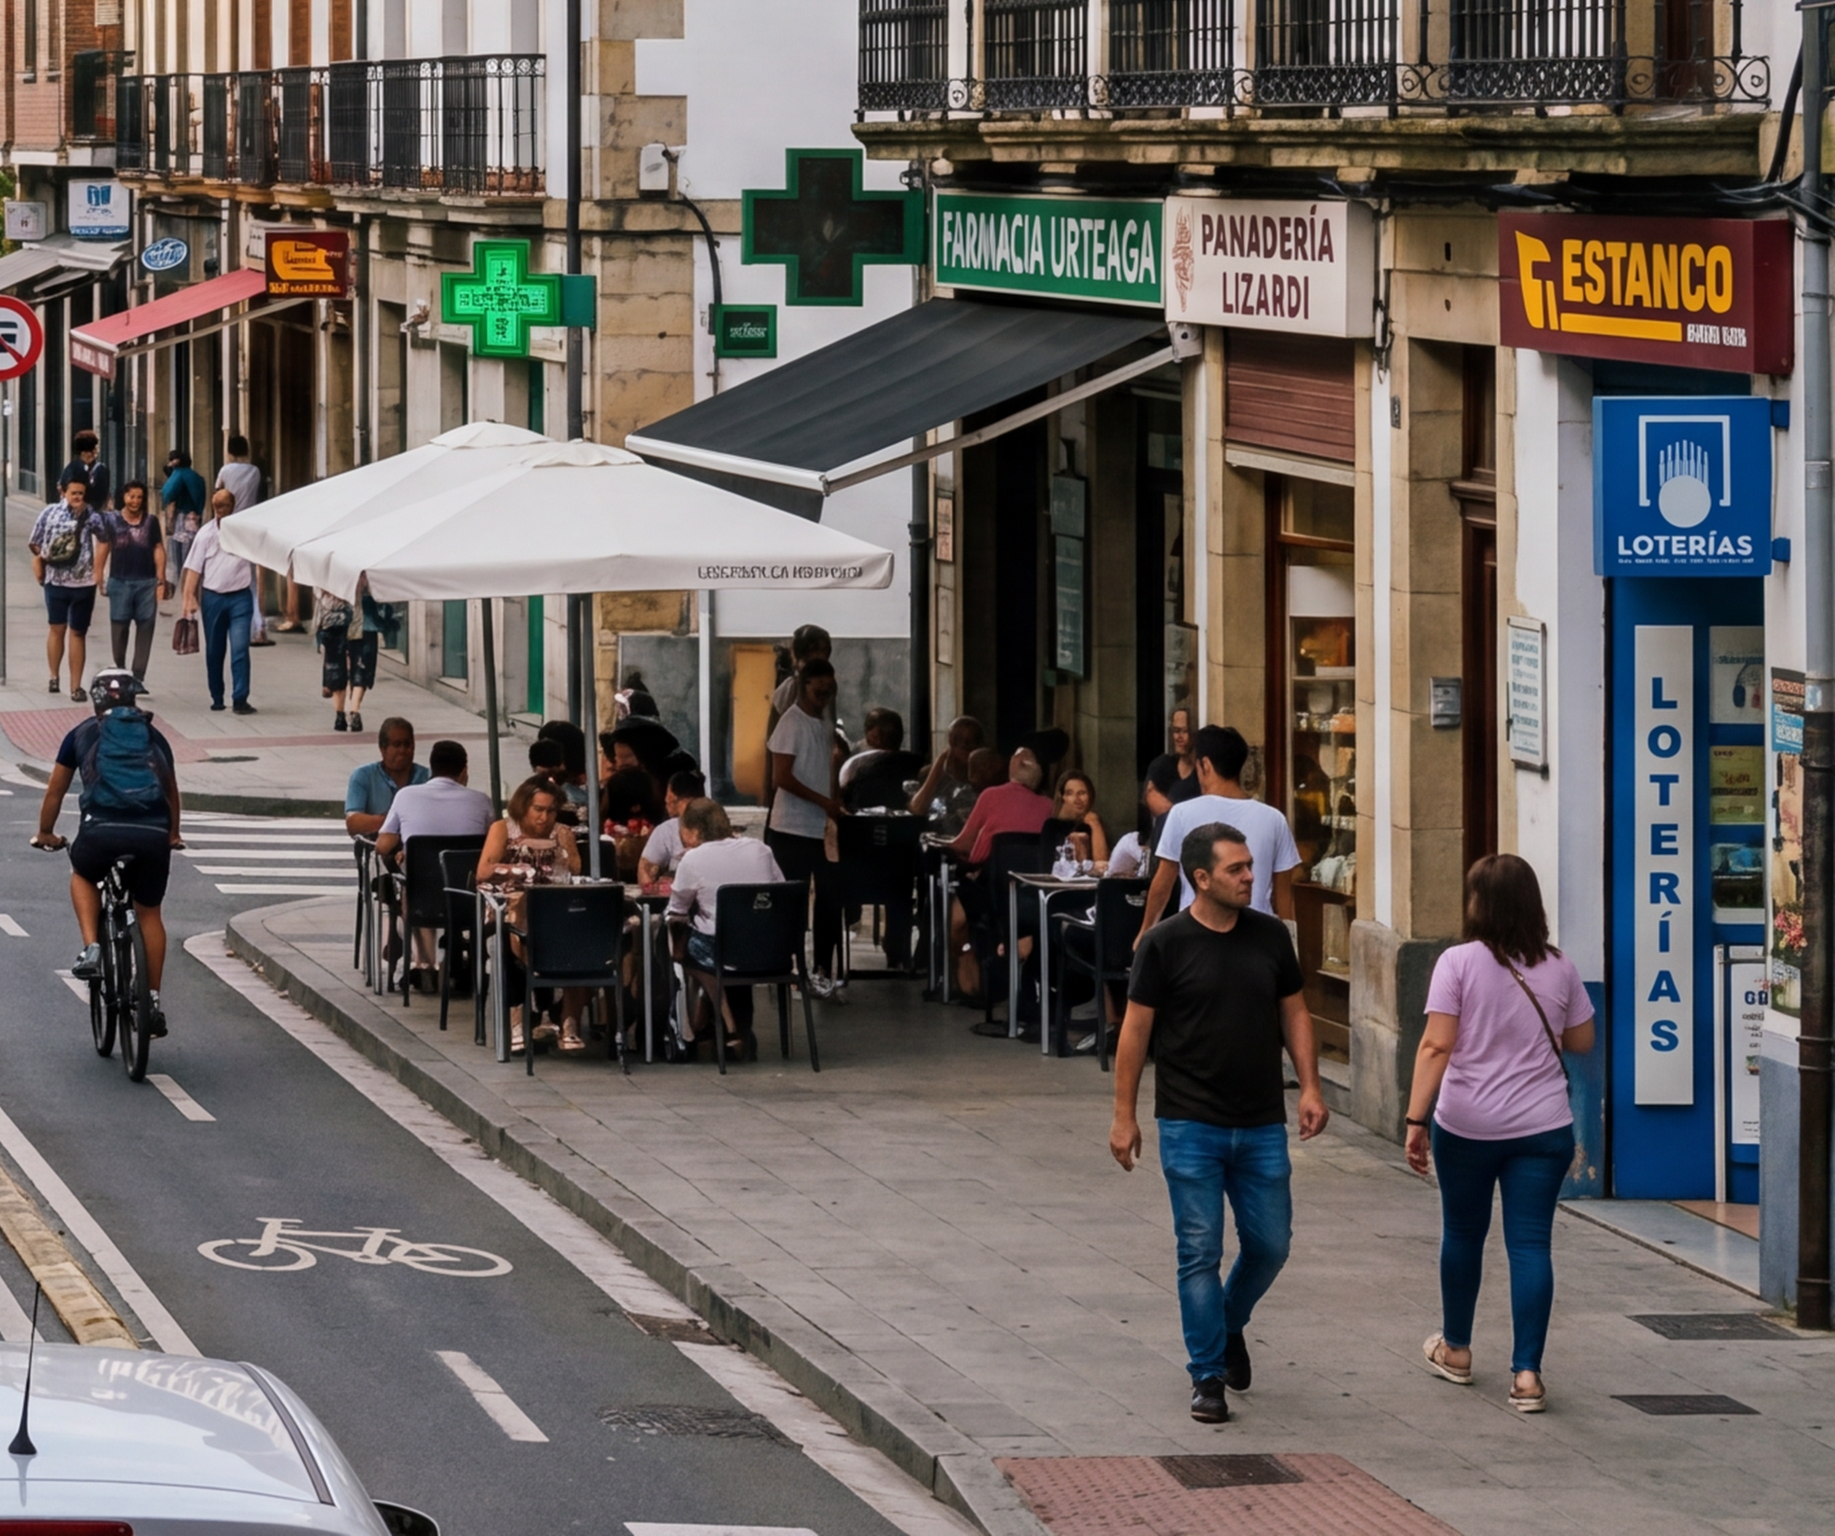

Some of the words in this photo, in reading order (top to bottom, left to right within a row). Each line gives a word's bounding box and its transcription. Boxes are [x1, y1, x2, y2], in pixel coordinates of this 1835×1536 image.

[942, 210, 1045, 276] FARMACIA
[1050, 216, 1157, 285] URTEAGA
[1201, 204, 1335, 263] PANADERÍA
[1222, 271, 1310, 320] LIZARDI
[1562, 238, 1733, 314] ESTANCO
[1617, 530, 1753, 556] LOTERÍAS
[1646, 676, 1682, 1052] LOTERÍAS
